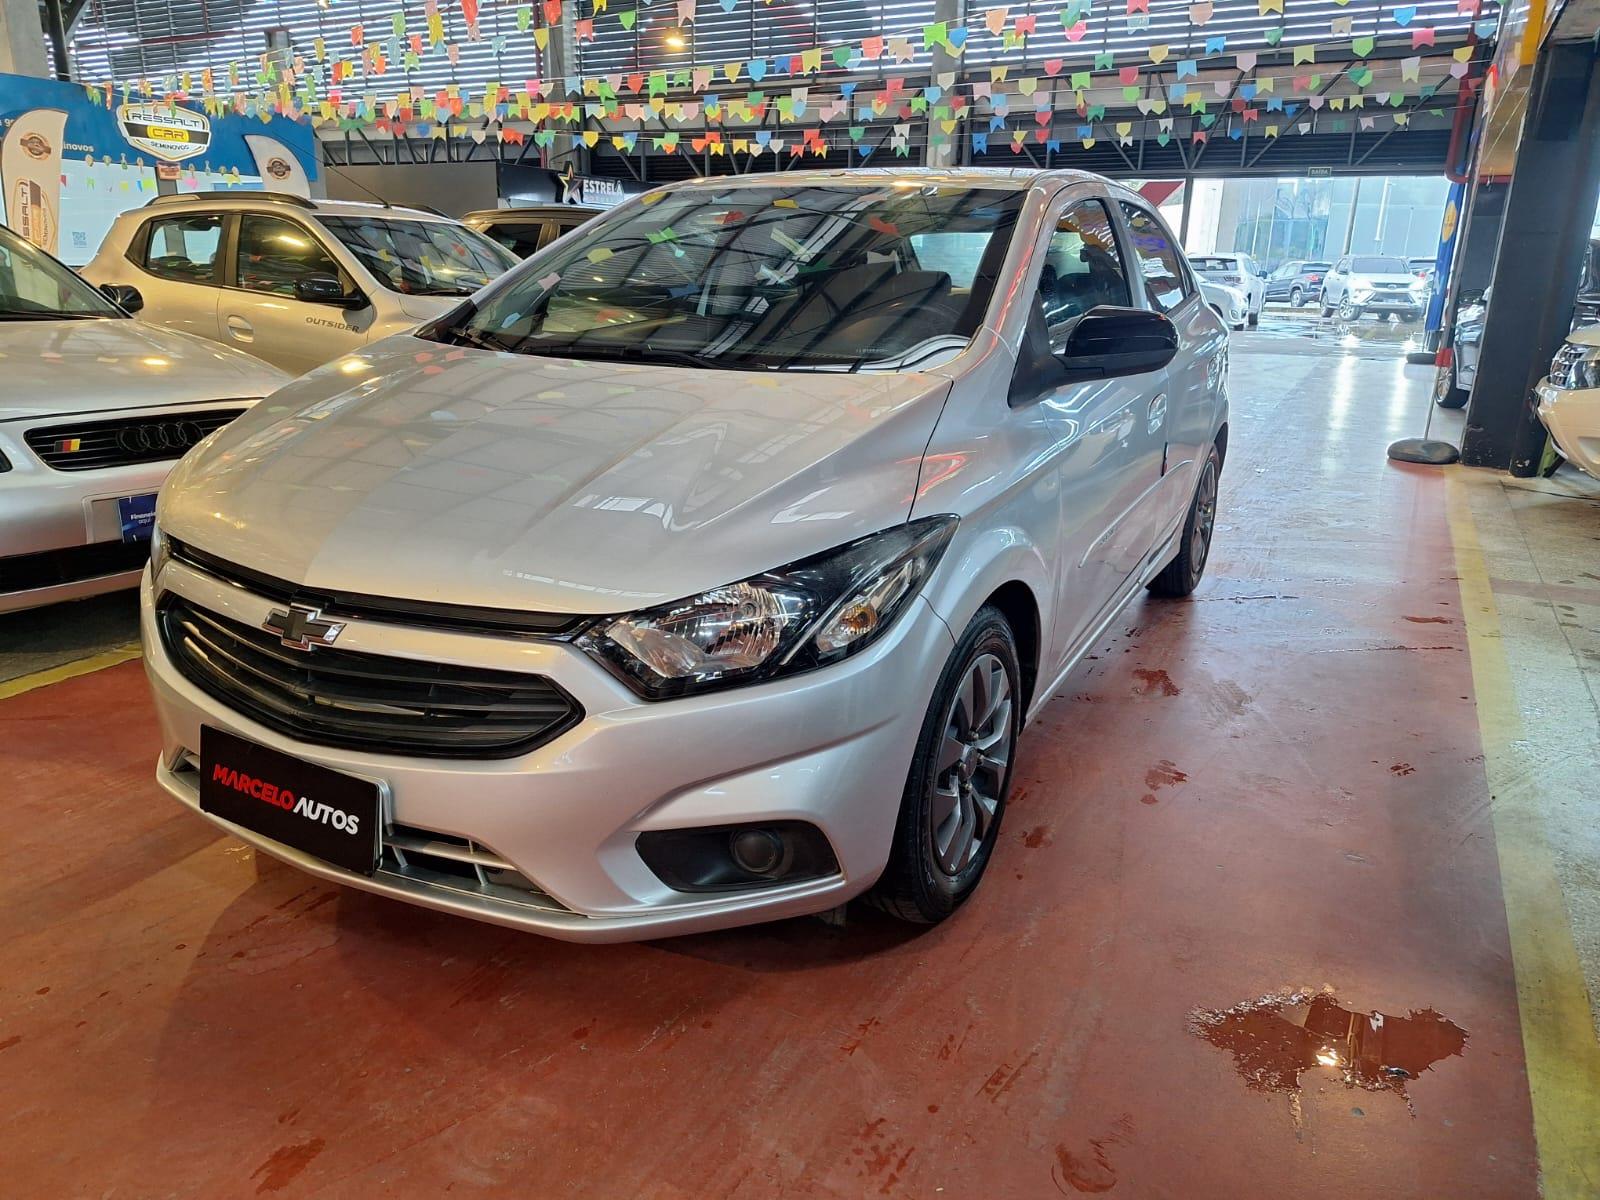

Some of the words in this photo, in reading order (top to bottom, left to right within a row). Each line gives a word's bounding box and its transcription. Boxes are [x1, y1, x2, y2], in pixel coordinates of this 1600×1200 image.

[131, 112, 200, 127] RESSALT
[152, 128, 185, 140] CAR
[150, 140, 190, 150] SEMINOVOS
[305, 316, 360, 334] OUTSIDER
[212, 763, 295, 811] MARCELO
[293, 796, 360, 835] AUTOS
